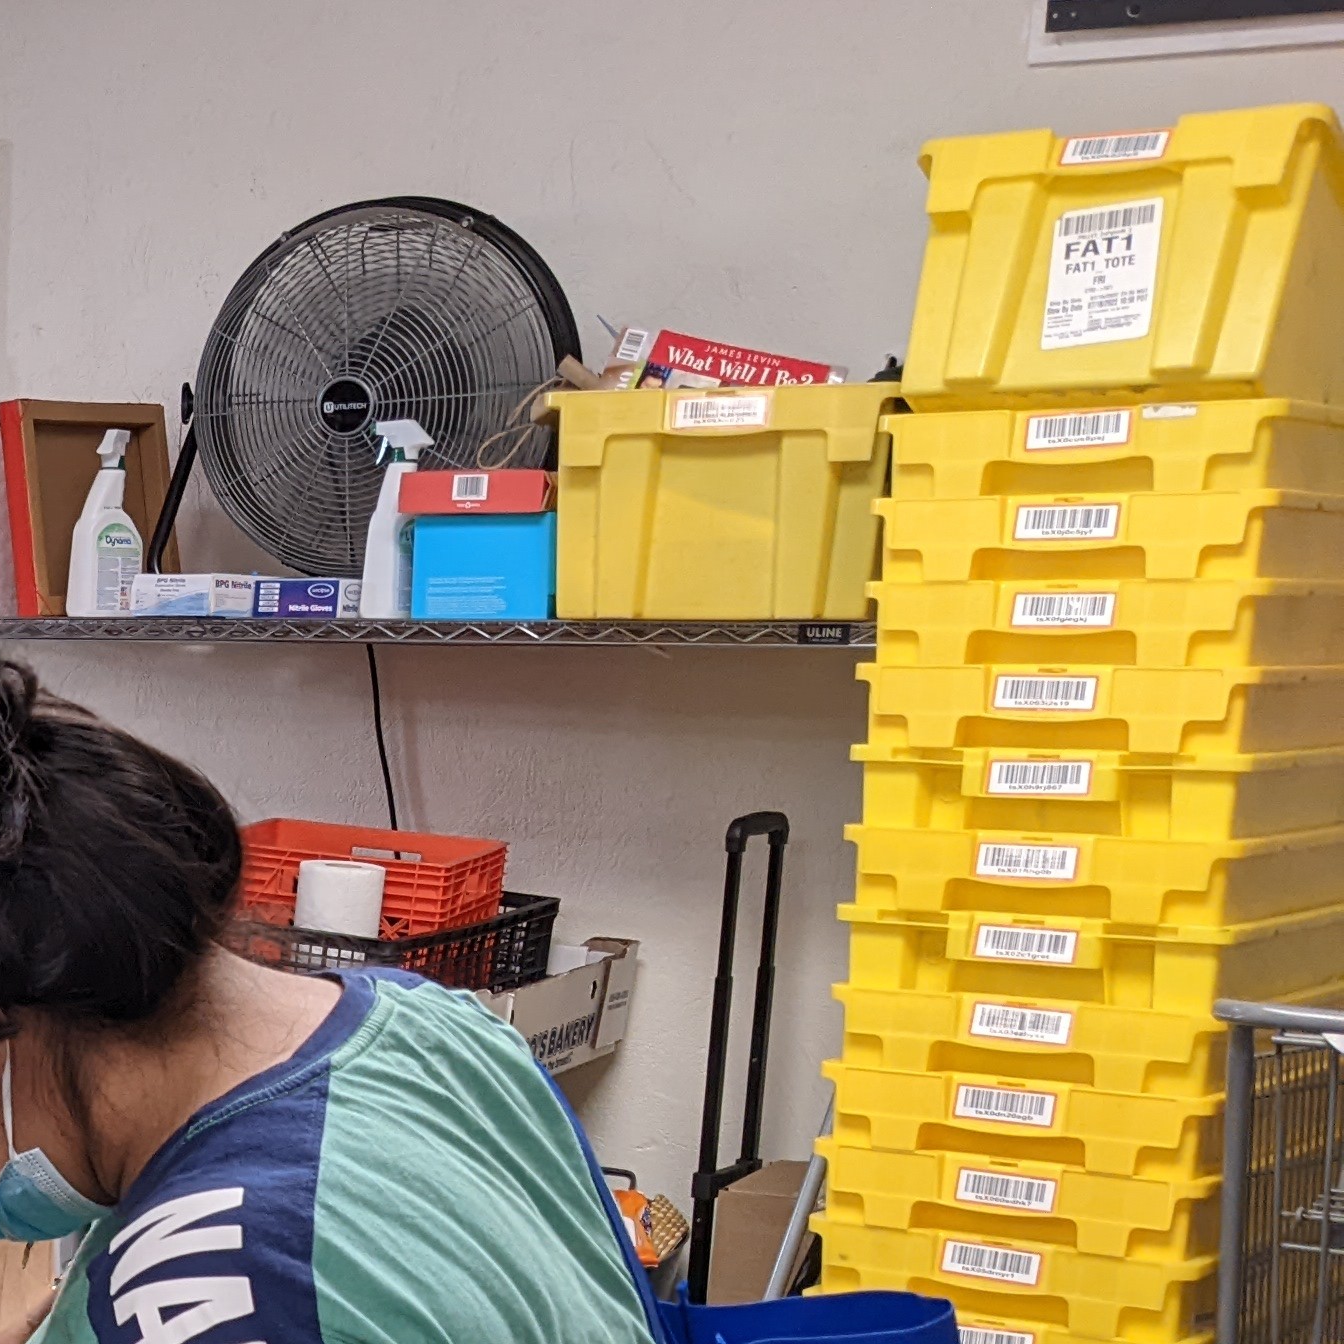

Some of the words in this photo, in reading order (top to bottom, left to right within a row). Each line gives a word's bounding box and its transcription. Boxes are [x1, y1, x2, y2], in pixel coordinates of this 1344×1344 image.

[1064, 234, 1133, 260] FAT1
[1065, 261, 1095, 275] FAT1
[1103, 254, 1136, 269] TOTE
[704, 345, 742, 360] JAMES
[667, 346, 714, 373] What
[719, 359, 757, 384] Will
[759, 367, 771, 386] I
[335, 402, 367, 411] UTILITECH
[215, 580, 230, 589] BPG
[288, 604, 309, 612] Nitrile
[310, 604, 333, 612] Gloves
[806, 627, 843, 638] ULINE
[548, 1012, 596, 1059] BAKERY
